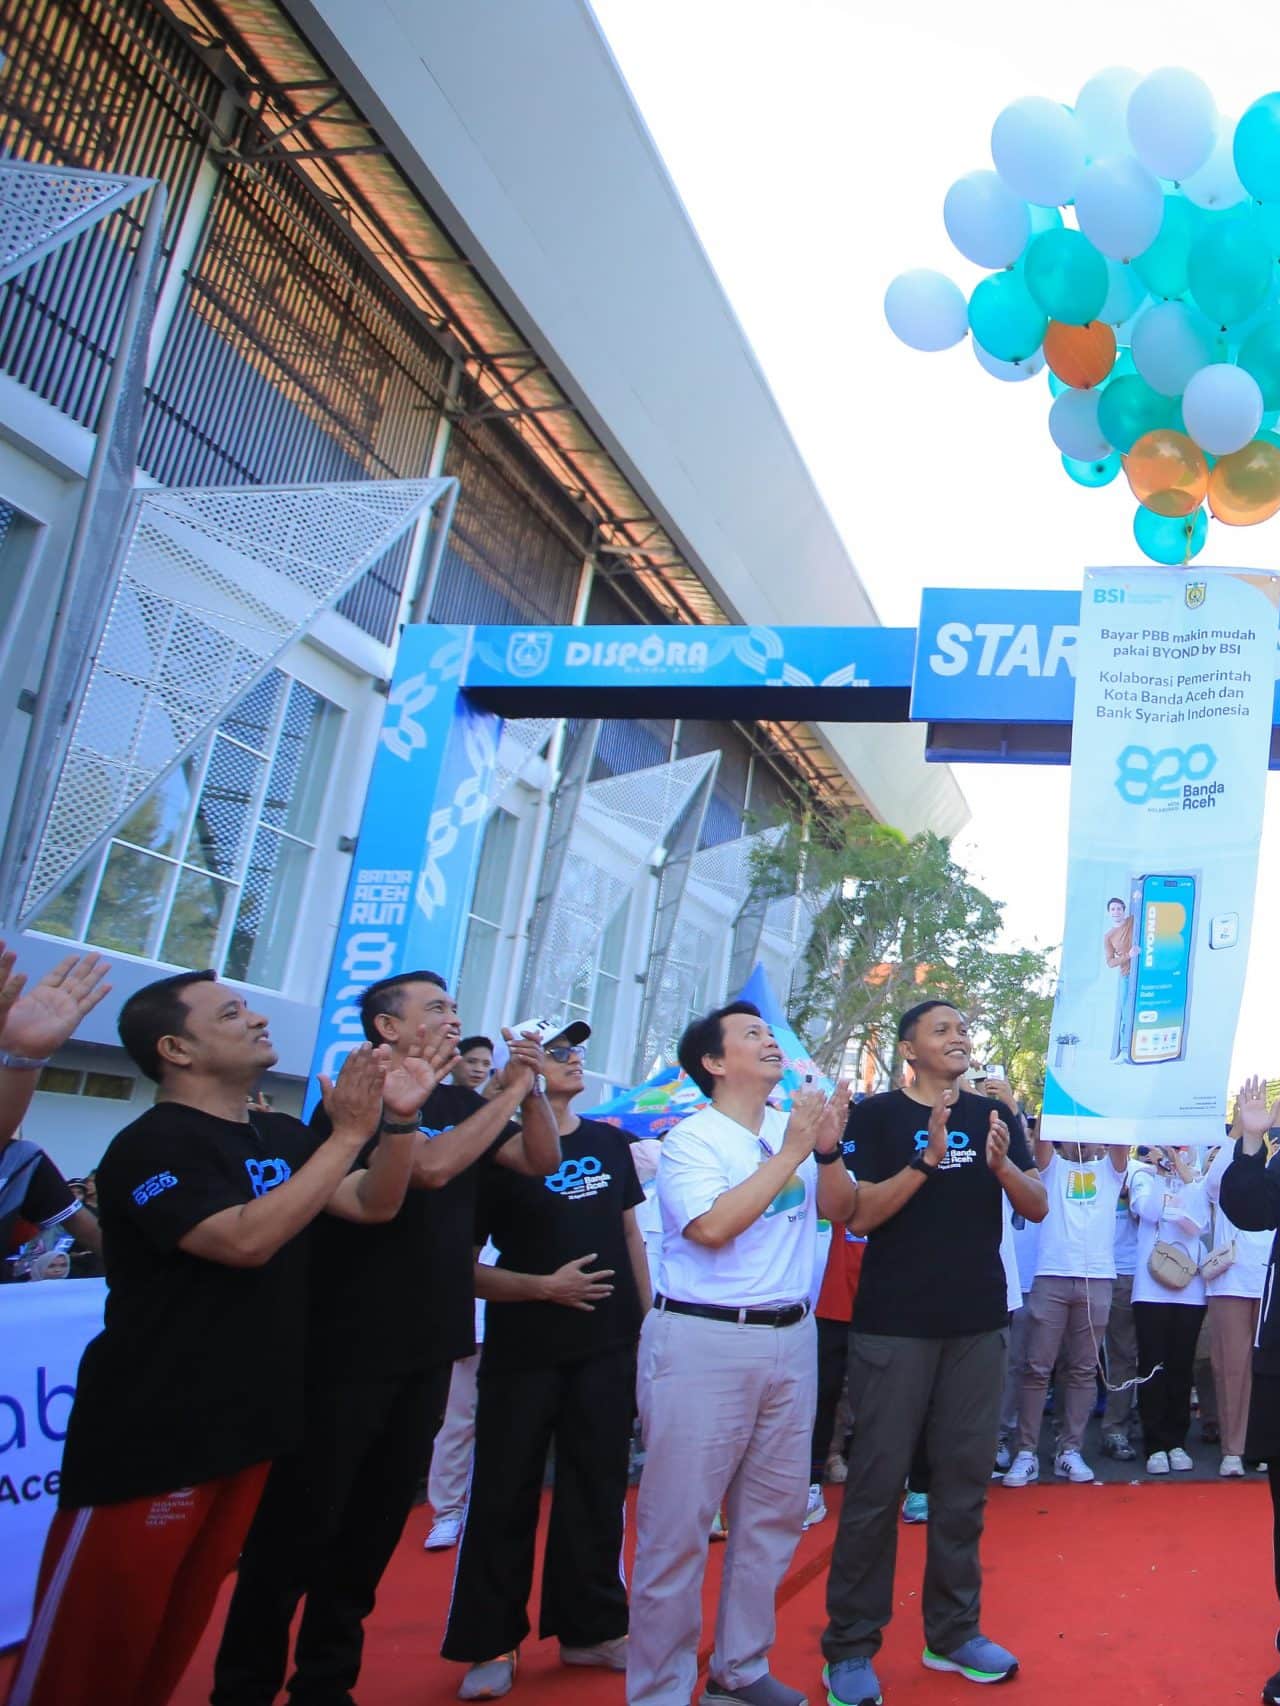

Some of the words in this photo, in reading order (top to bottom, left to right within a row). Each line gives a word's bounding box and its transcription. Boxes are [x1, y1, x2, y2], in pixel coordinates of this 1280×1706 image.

[1093, 588, 1125, 604] BSI
[1100, 629, 1139, 642] Bayar
[1142, 630, 1170, 642] PBB
[1173, 628, 1208, 643] makin
[1211, 628, 1256, 641] mudah
[929, 622, 1081, 678] STAR
[1113, 645, 1150, 658] pakai
[1152, 646, 1199, 660] BYOND
[1201, 643, 1216, 656] by
[1219, 643, 1241, 655] BSI
[1099, 671, 1174, 688] Kolaborasi
[1177, 669, 1251, 686] Pemerintah
[1104, 688, 1138, 702] Kota
[1141, 690, 1183, 705] Banda
[1185, 689, 1216, 704] Aceh
[1218, 686, 1244, 700] dan
[1096, 706, 1132, 720] Bank
[1135, 708, 1185, 724] Syariah
[1187, 704, 1250, 721] Indonesia
[1183, 781, 1225, 797] Banda
[1182, 795, 1216, 810] Aceh
[353, 884, 410, 902] ACEH
[348, 902, 407, 925] RUN
[0, 1469, 62, 1505] Ace
